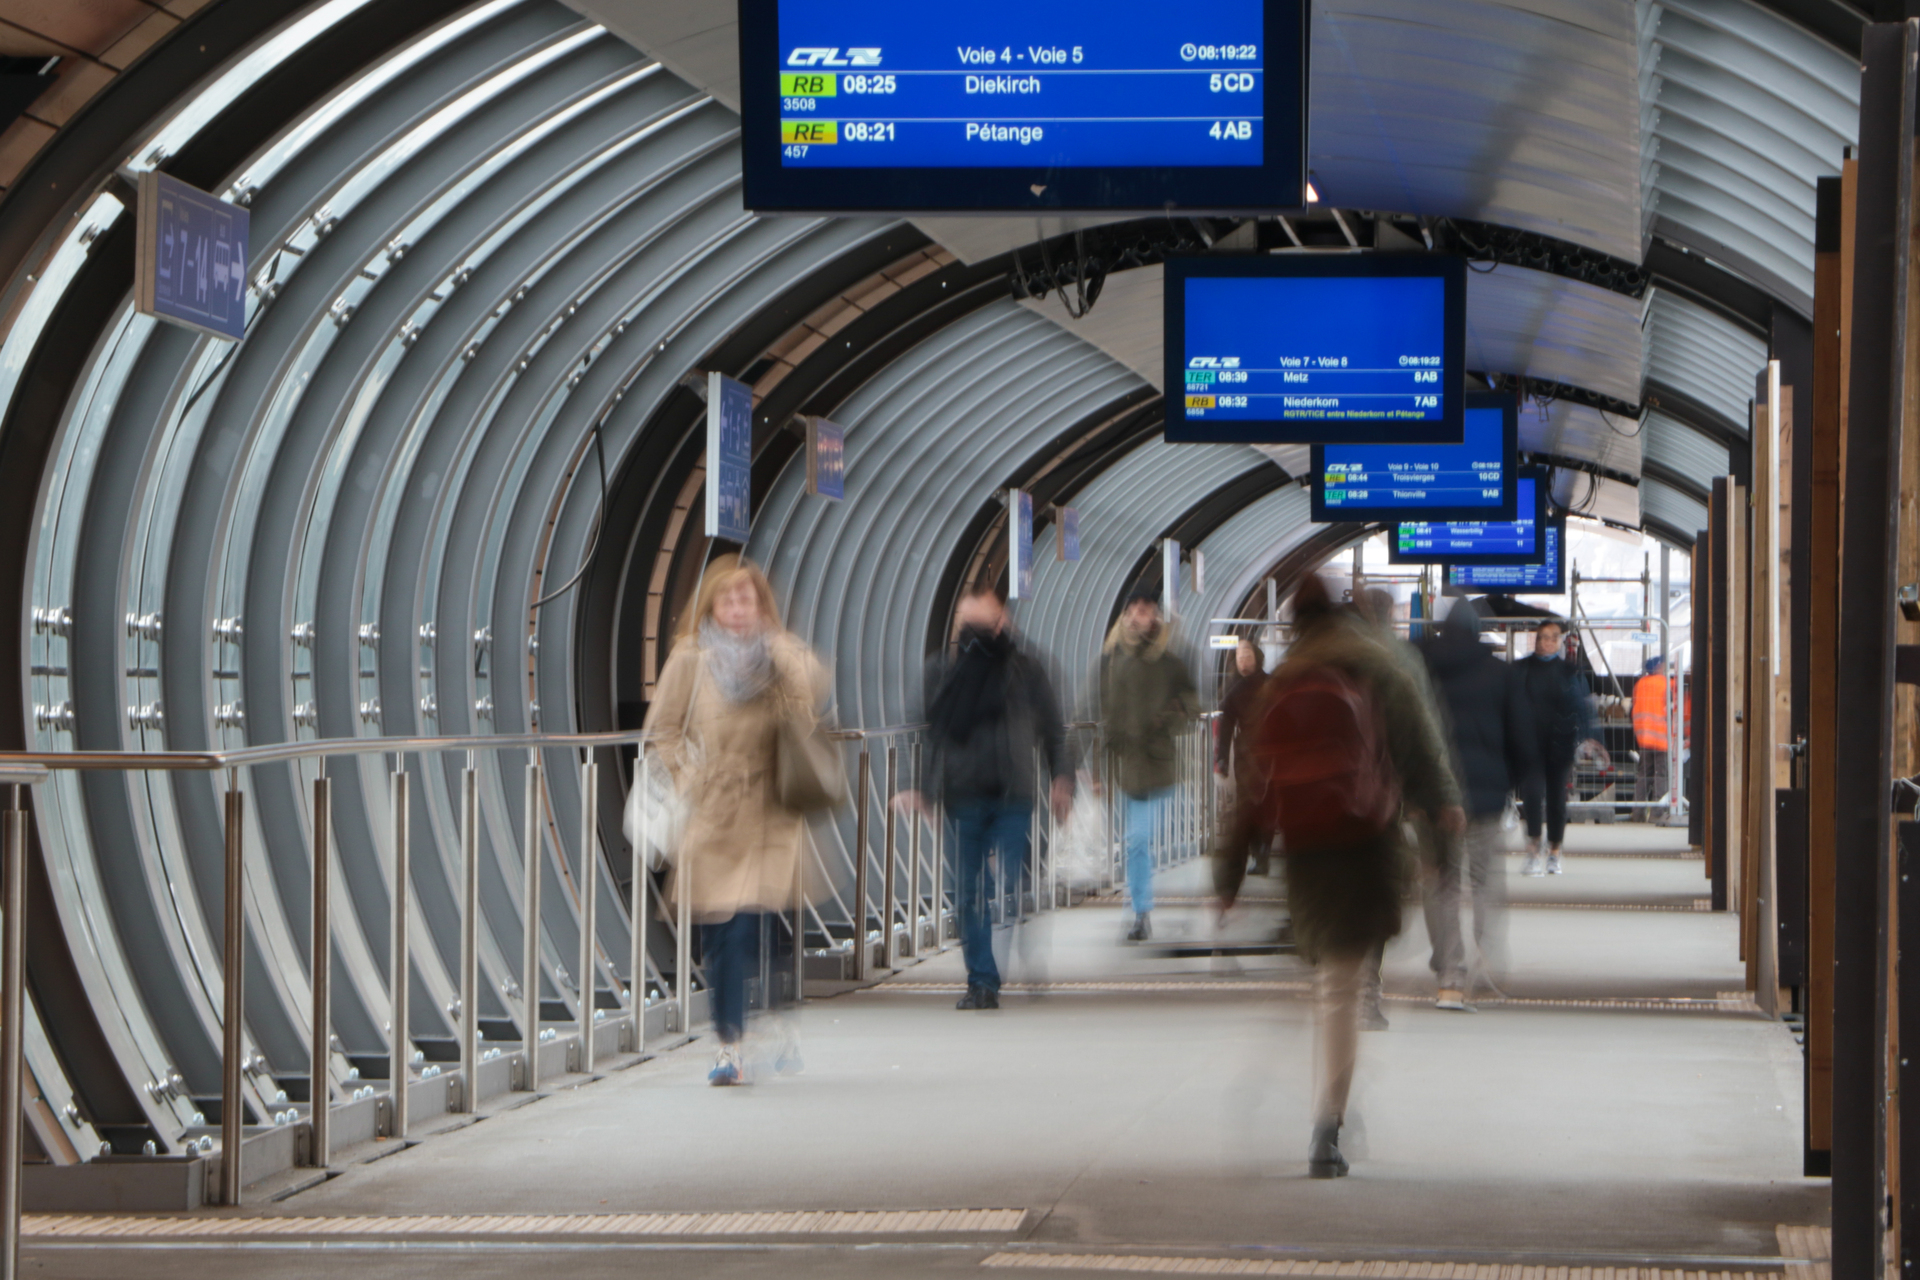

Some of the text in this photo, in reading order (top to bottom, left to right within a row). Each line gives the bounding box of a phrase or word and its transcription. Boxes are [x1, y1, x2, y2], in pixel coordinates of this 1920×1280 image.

[787, 48, 849, 66] CFL
[958, 47, 996, 65] Voie
[1001, 46, 1011, 64] 4
[1029, 46, 1067, 64] Voie
[1073, 46, 1083, 64] 5
[1198, 45, 1256, 60] 08:19:22
[793, 75, 896, 94] RB 08:25
[966, 75, 1040, 94] Diekirch
[784, 97, 816, 111] 3508
[794, 122, 894, 142] RE 08:21
[966, 123, 1043, 145] Pétange
[785, 144, 810, 158] 457
[1280, 357, 1301, 368] Voie
[1304, 356, 1309, 367] 7
[1318, 357, 1339, 368] Voie
[1341, 356, 1348, 368] 8
[1408, 356, 1440, 366] 08:19:22
[1188, 370, 1248, 383] TER 08:39
[1284, 371, 1308, 383] Metz
[1191, 395, 1247, 408] RB 08:32
[1284, 396, 1339, 408] Niederkorn
[1347, 410, 1385, 418] Niederkorn
[1396, 410, 1425, 419] Pétange
[1393, 473, 1435, 483] Troisvierges
[1328, 491, 1345, 499] TER
[1393, 489, 1426, 499] Thionville
